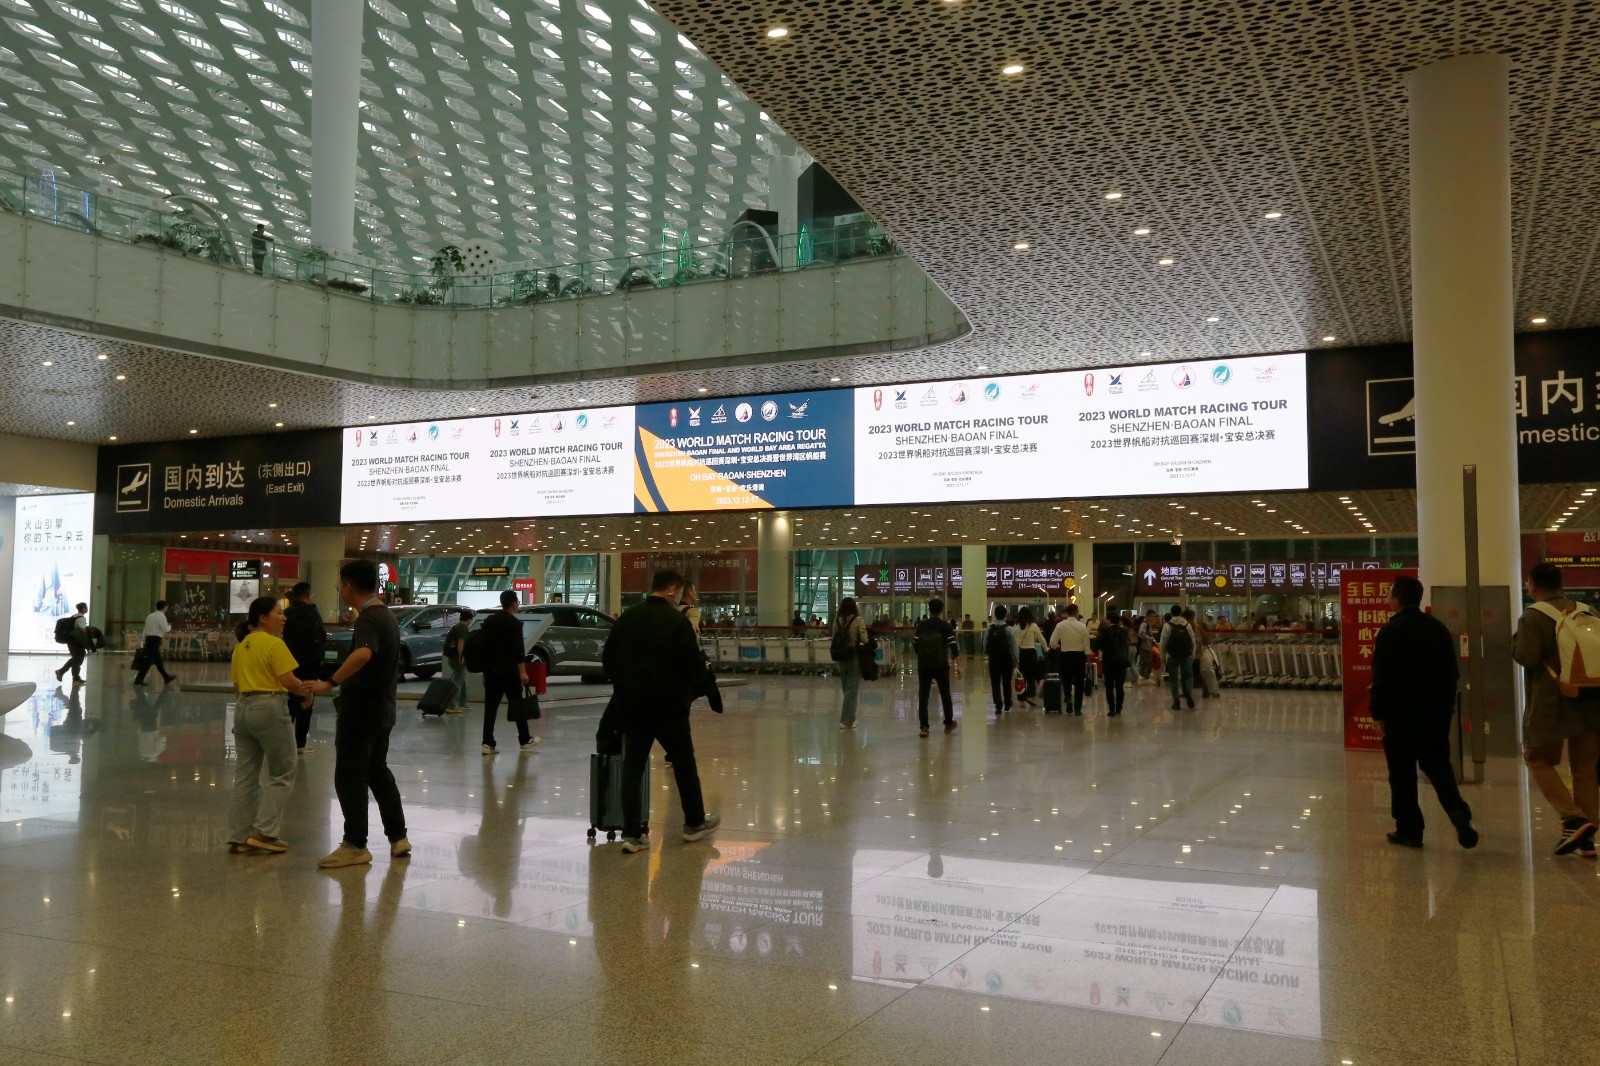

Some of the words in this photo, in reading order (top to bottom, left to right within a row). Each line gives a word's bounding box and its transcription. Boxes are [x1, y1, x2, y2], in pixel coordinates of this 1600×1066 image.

[1079, 411, 1106, 422] 2023
[1108, 408, 1150, 420] WORLD
[1154, 406, 1196, 418] MATCH
[1200, 402, 1248, 414] RACING
[1252, 400, 1288, 411] TOUR
[868, 424, 892, 434] 2023
[895, 422, 930, 432] WORLD
[934, 420, 970, 430] MATCH
[974, 417, 1014, 428] RACING
[1018, 415, 1048, 426] TOUR
[1219, 416, 1253, 427] FINAL
[654, 440, 675, 450] 2023
[678, 436, 714, 448] WORLD
[716, 434, 750, 446] MATCH
[754, 431, 793, 444] RACING
[796, 428, 826, 440] TOUR
[990, 430, 1018, 440] FINAL
[1517, 423, 1600, 444] mestic
[490, 450, 507, 458] 2023
[510, 448, 536, 456] WORLD
[538, 446, 565, 454] MATCH
[568, 444, 598, 452] RACING
[600, 442, 622, 450] TOUR
[369, 456, 392, 465] WORLD
[394, 455, 418, 463] MATCH
[421, 454, 447, 462] RACING
[580, 454, 601, 464] FINAL
[258, 461, 311, 479] (东侧出口)
[430, 464, 450, 472] FINAL
[164, 461, 244, 492] 国内到达
[266, 484, 286, 496] (East
[288, 483, 304, 494] Exit)
[164, 496, 206, 508] Domestic
[208, 494, 244, 506] Arrivals
[24, 518, 63, 530] 火山引擎
[24, 531, 83, 544] 你的下一朵云
[185, 585, 206, 603] It's
